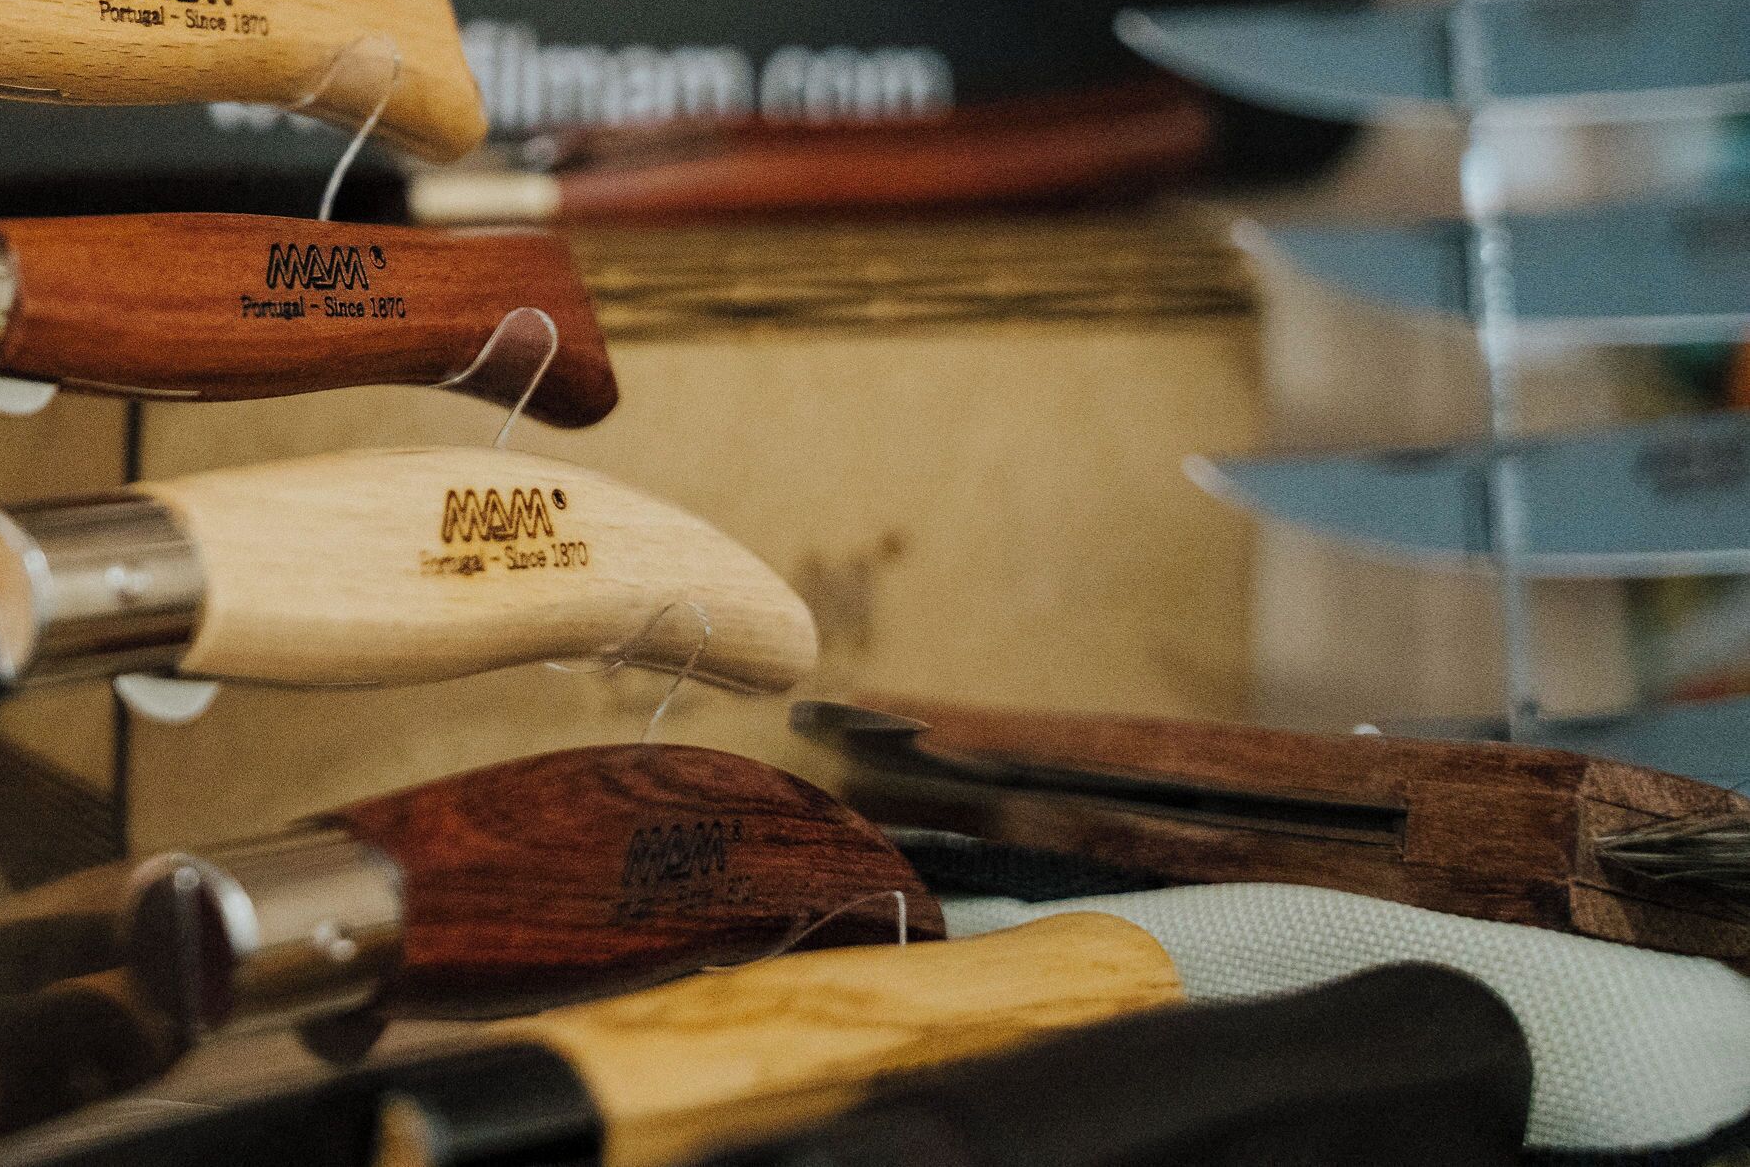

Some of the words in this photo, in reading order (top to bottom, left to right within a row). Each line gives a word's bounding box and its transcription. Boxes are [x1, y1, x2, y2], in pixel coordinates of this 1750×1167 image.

[99, 0, 166, 27] Portugal
[185, 8, 228, 31] Since
[240, 294, 306, 320] Portugal
[324, 296, 365, 318] Since
[369, 297, 407, 319] 1870
[551, 540, 588, 568] 1870
